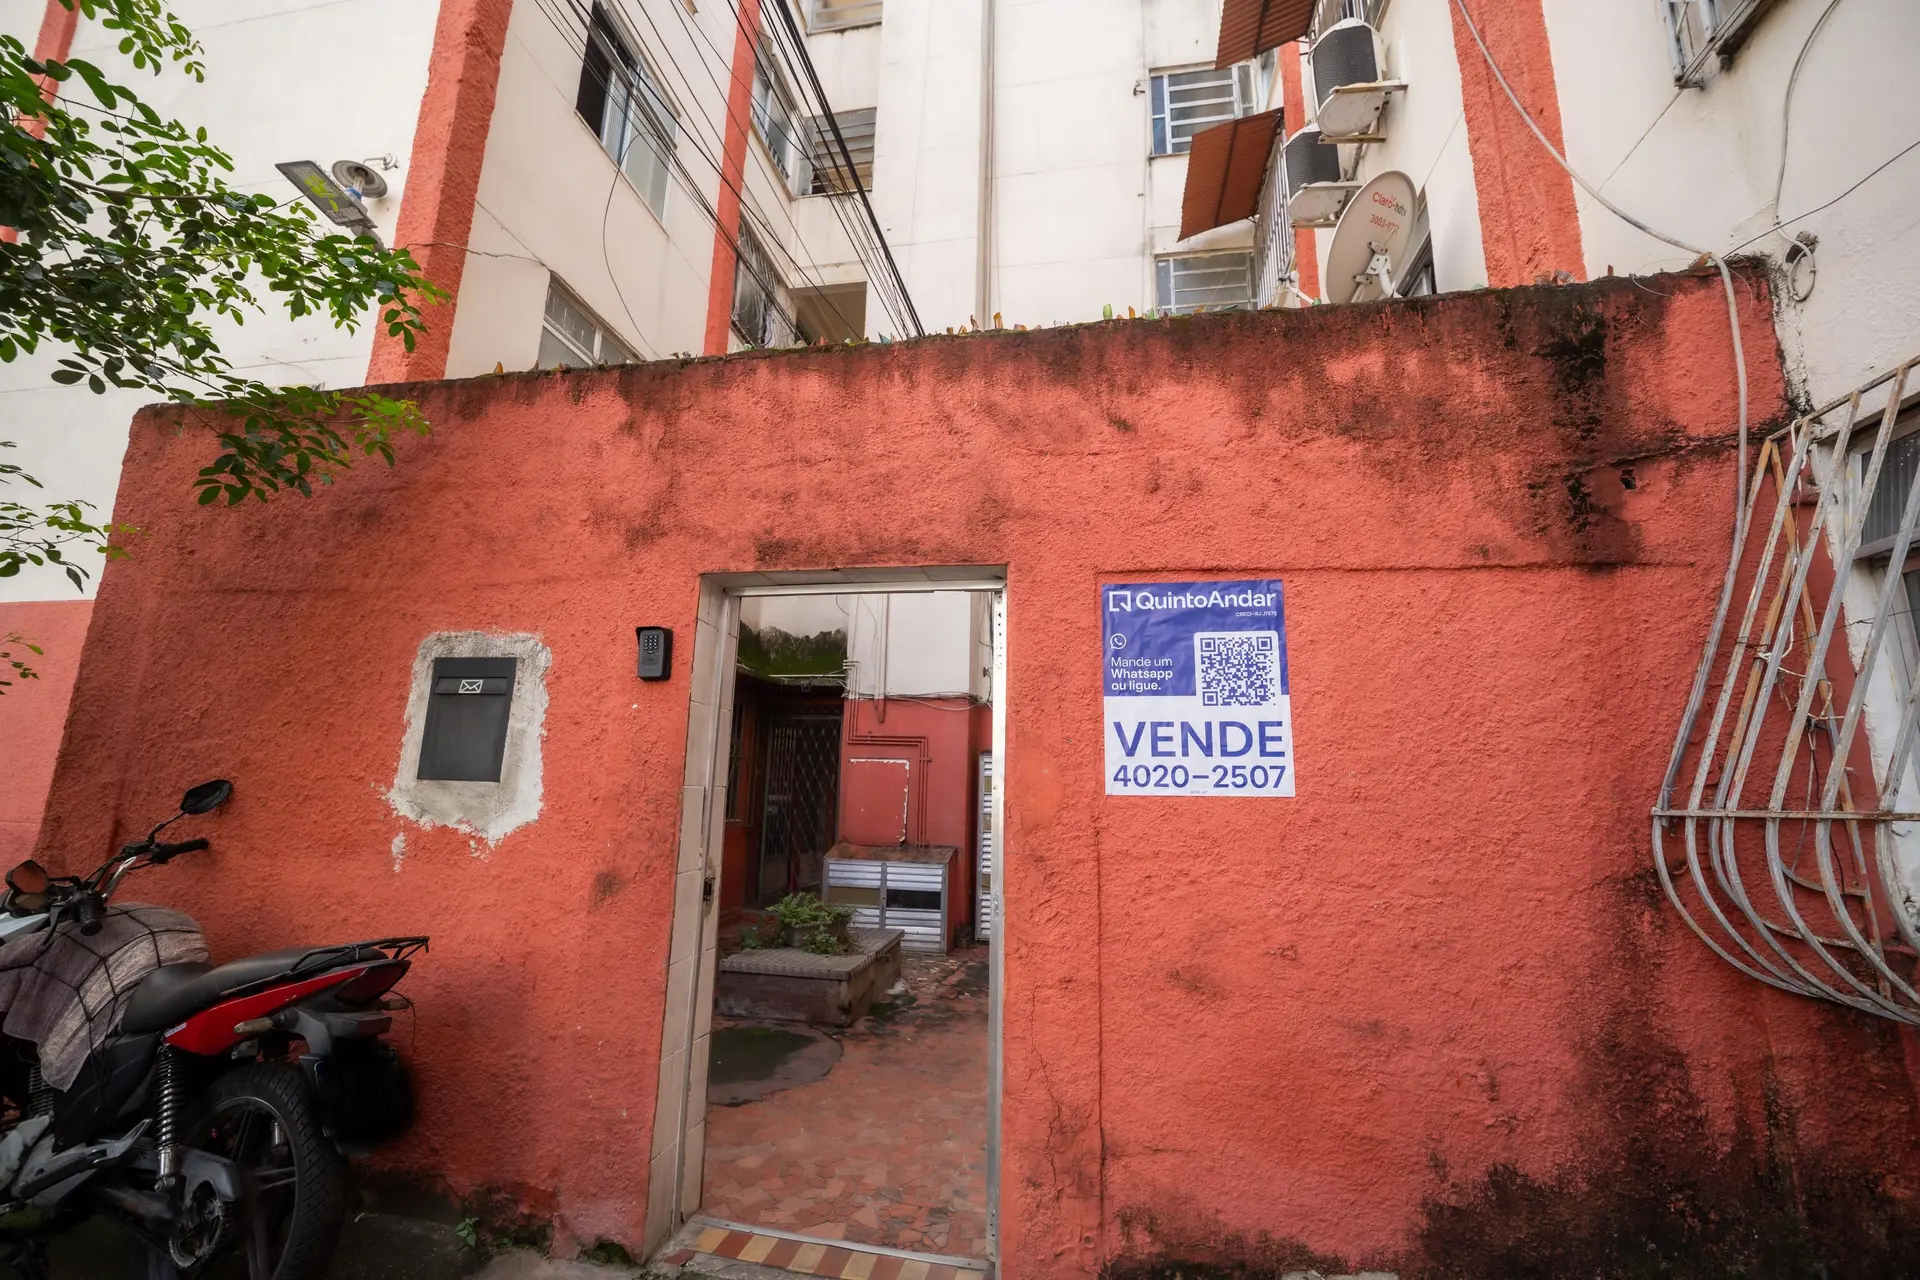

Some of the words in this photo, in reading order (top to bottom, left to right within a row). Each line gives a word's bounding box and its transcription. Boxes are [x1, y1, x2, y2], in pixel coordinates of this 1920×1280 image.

[1136, 590, 1276, 610] QuintoAndar
[1111, 656, 1150, 667] Mande
[1153, 658, 1173, 667] um
[1111, 668, 1173, 680] Whatsapp
[1111, 682, 1128, 690] ou
[1129, 680, 1161, 692] ligue.
[1113, 721, 1286, 758] VENDE
[1112, 764, 1287, 789] 4020-2507
